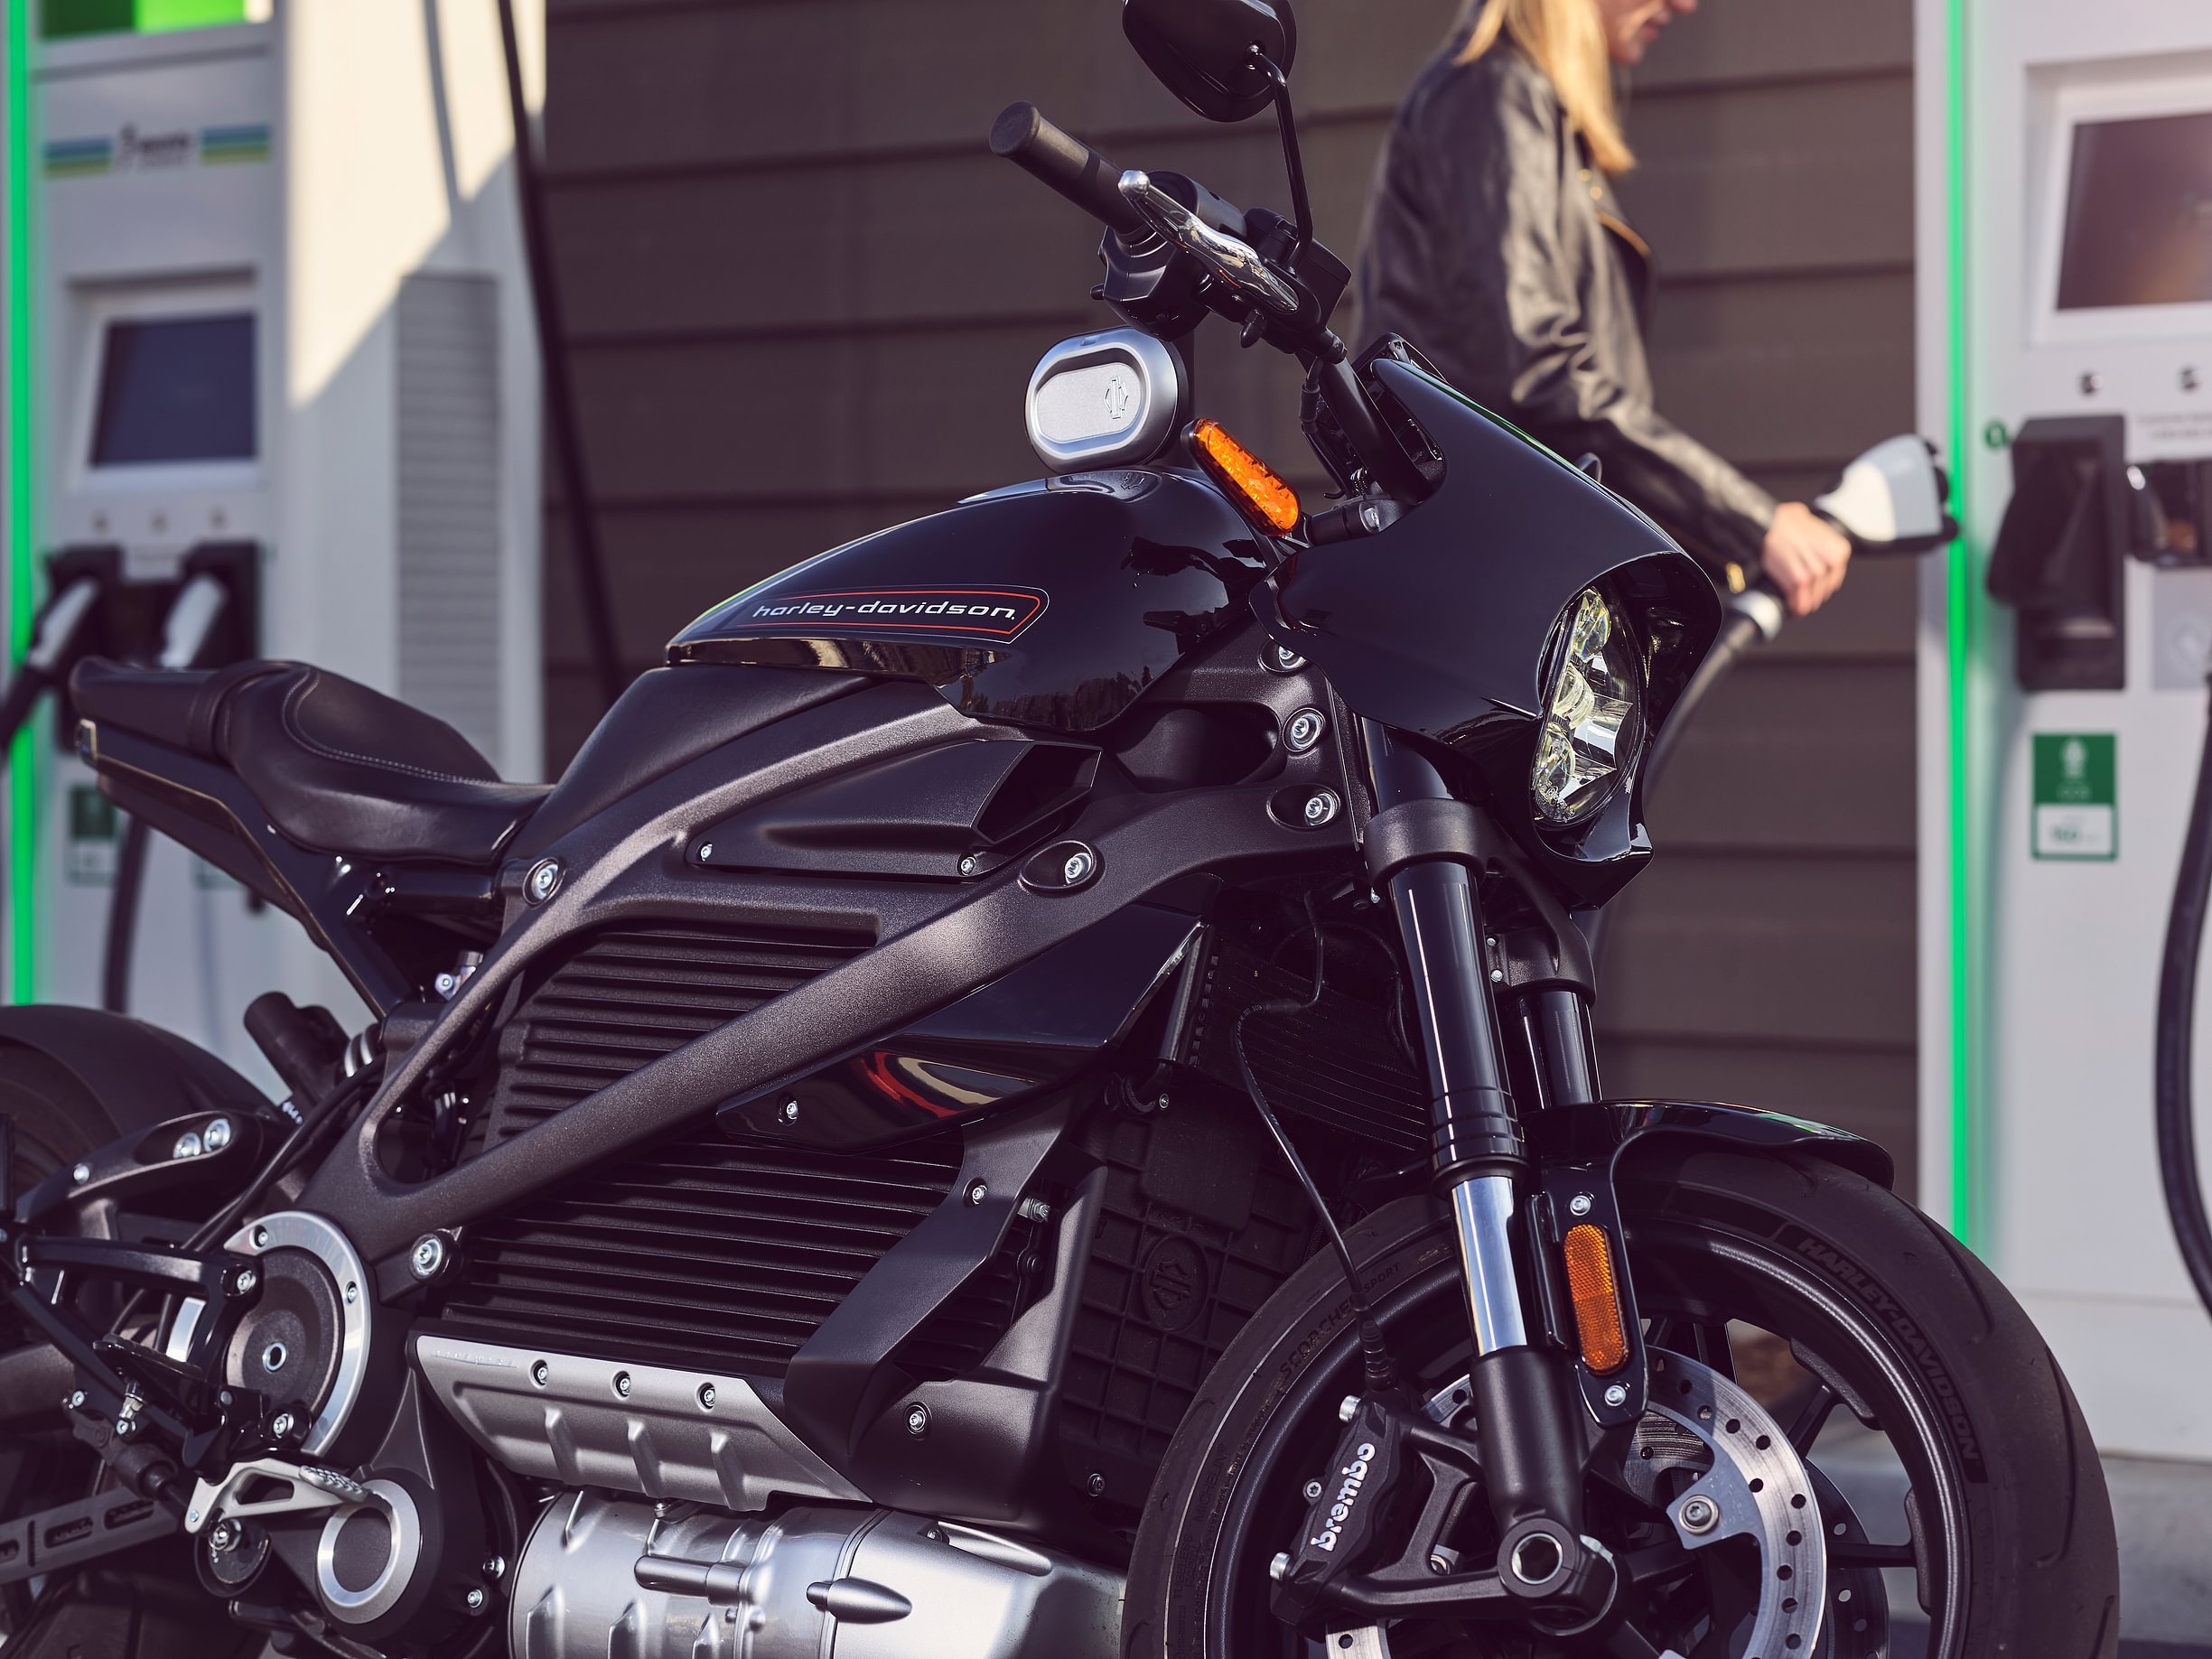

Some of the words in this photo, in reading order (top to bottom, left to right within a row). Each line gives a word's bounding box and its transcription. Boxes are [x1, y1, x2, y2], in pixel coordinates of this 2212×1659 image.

[1280, 1296, 1354, 1378] SCORCHE
[1363, 1263, 1401, 1293] SPORT
[1797, 1237, 1979, 1461] HARLEY-DAVIDSON
[1311, 1442, 1376, 1552] brembo
